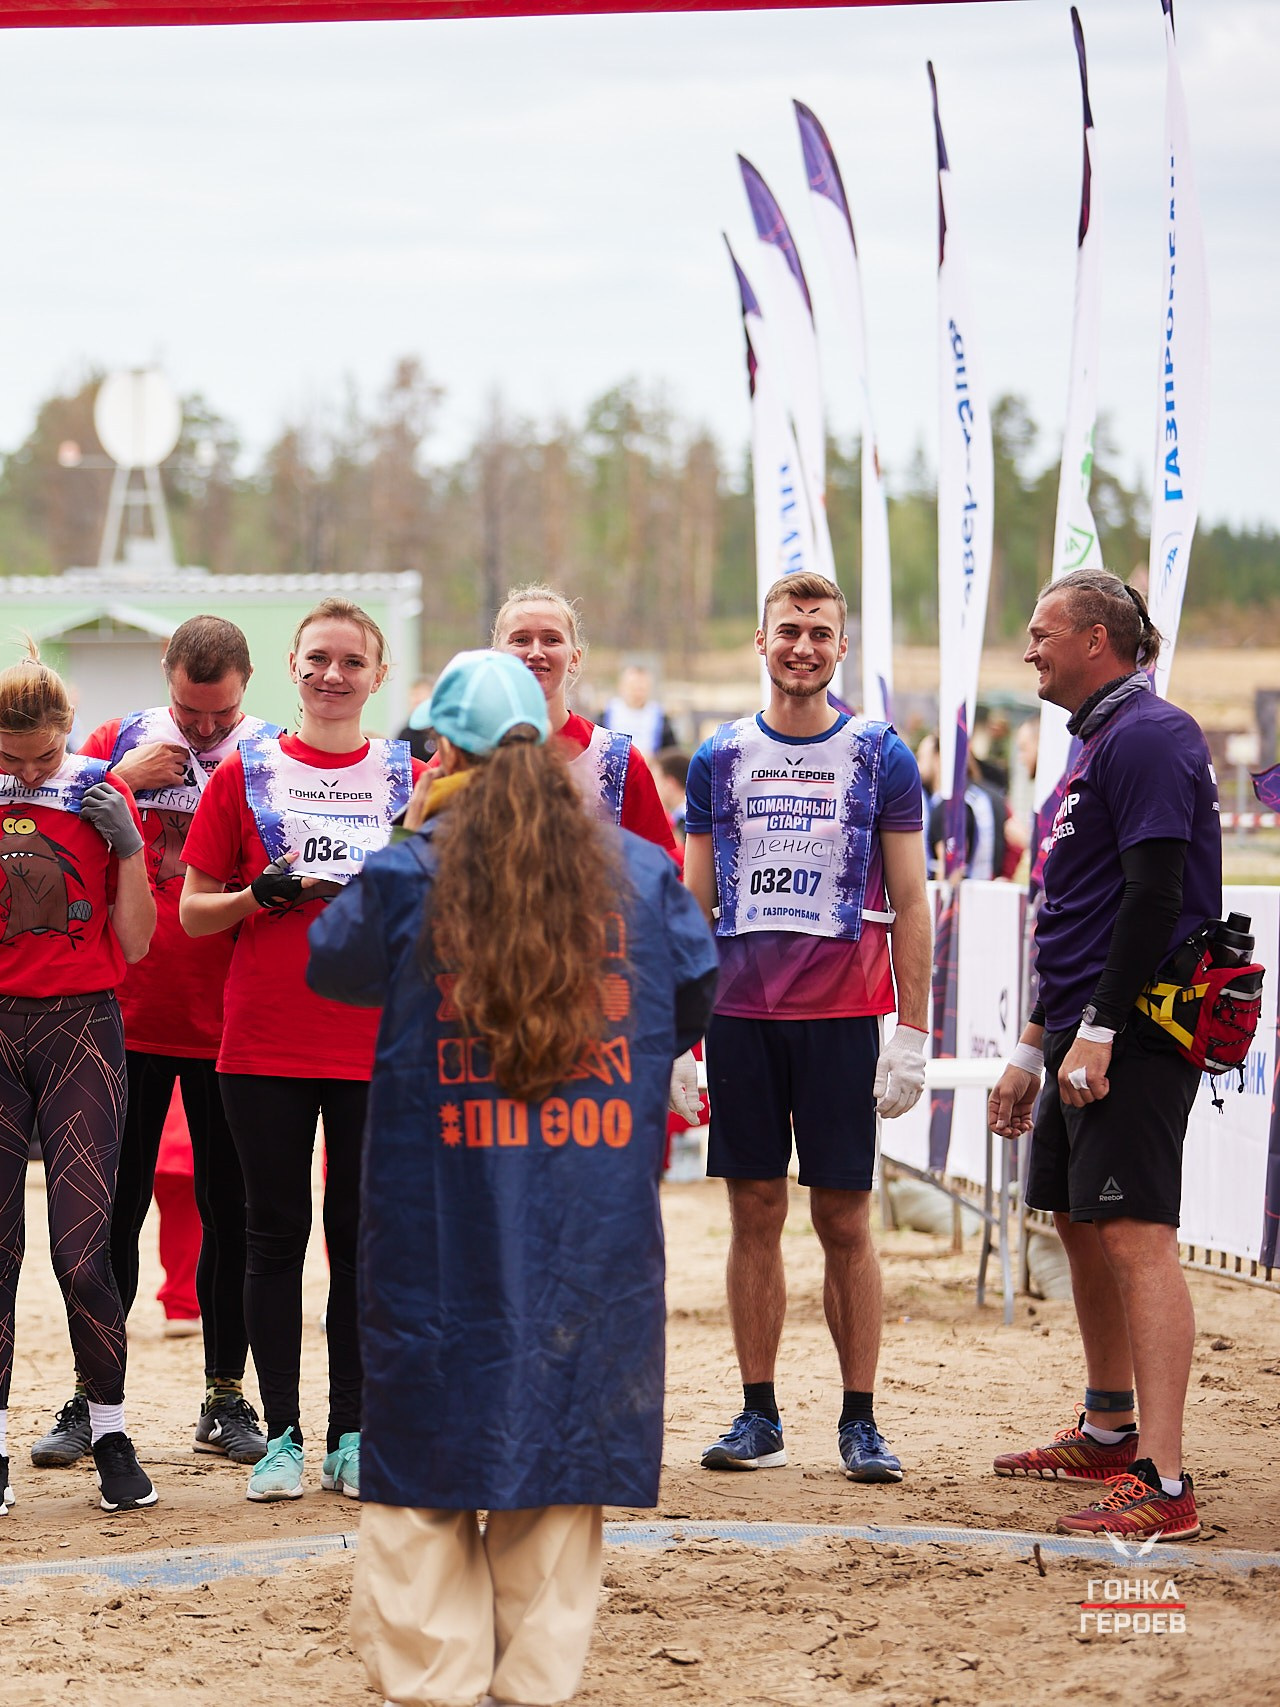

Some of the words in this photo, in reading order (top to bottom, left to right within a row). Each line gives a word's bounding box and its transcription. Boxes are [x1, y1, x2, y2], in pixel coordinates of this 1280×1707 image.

[751, 769, 788, 779] ГОНКА
[791, 770, 835, 781] ГЕРОЕВ
[288, 788, 326, 800] ГОНКА
[329, 791, 373, 800] ГЕРОЕВ
[748, 798, 835, 818] КОМАНДНЫЙ
[769, 816, 809, 831] СТАРТ
[750, 867, 822, 897] 03207
[762, 907, 820, 922] ГАЗПРОМБАНК
